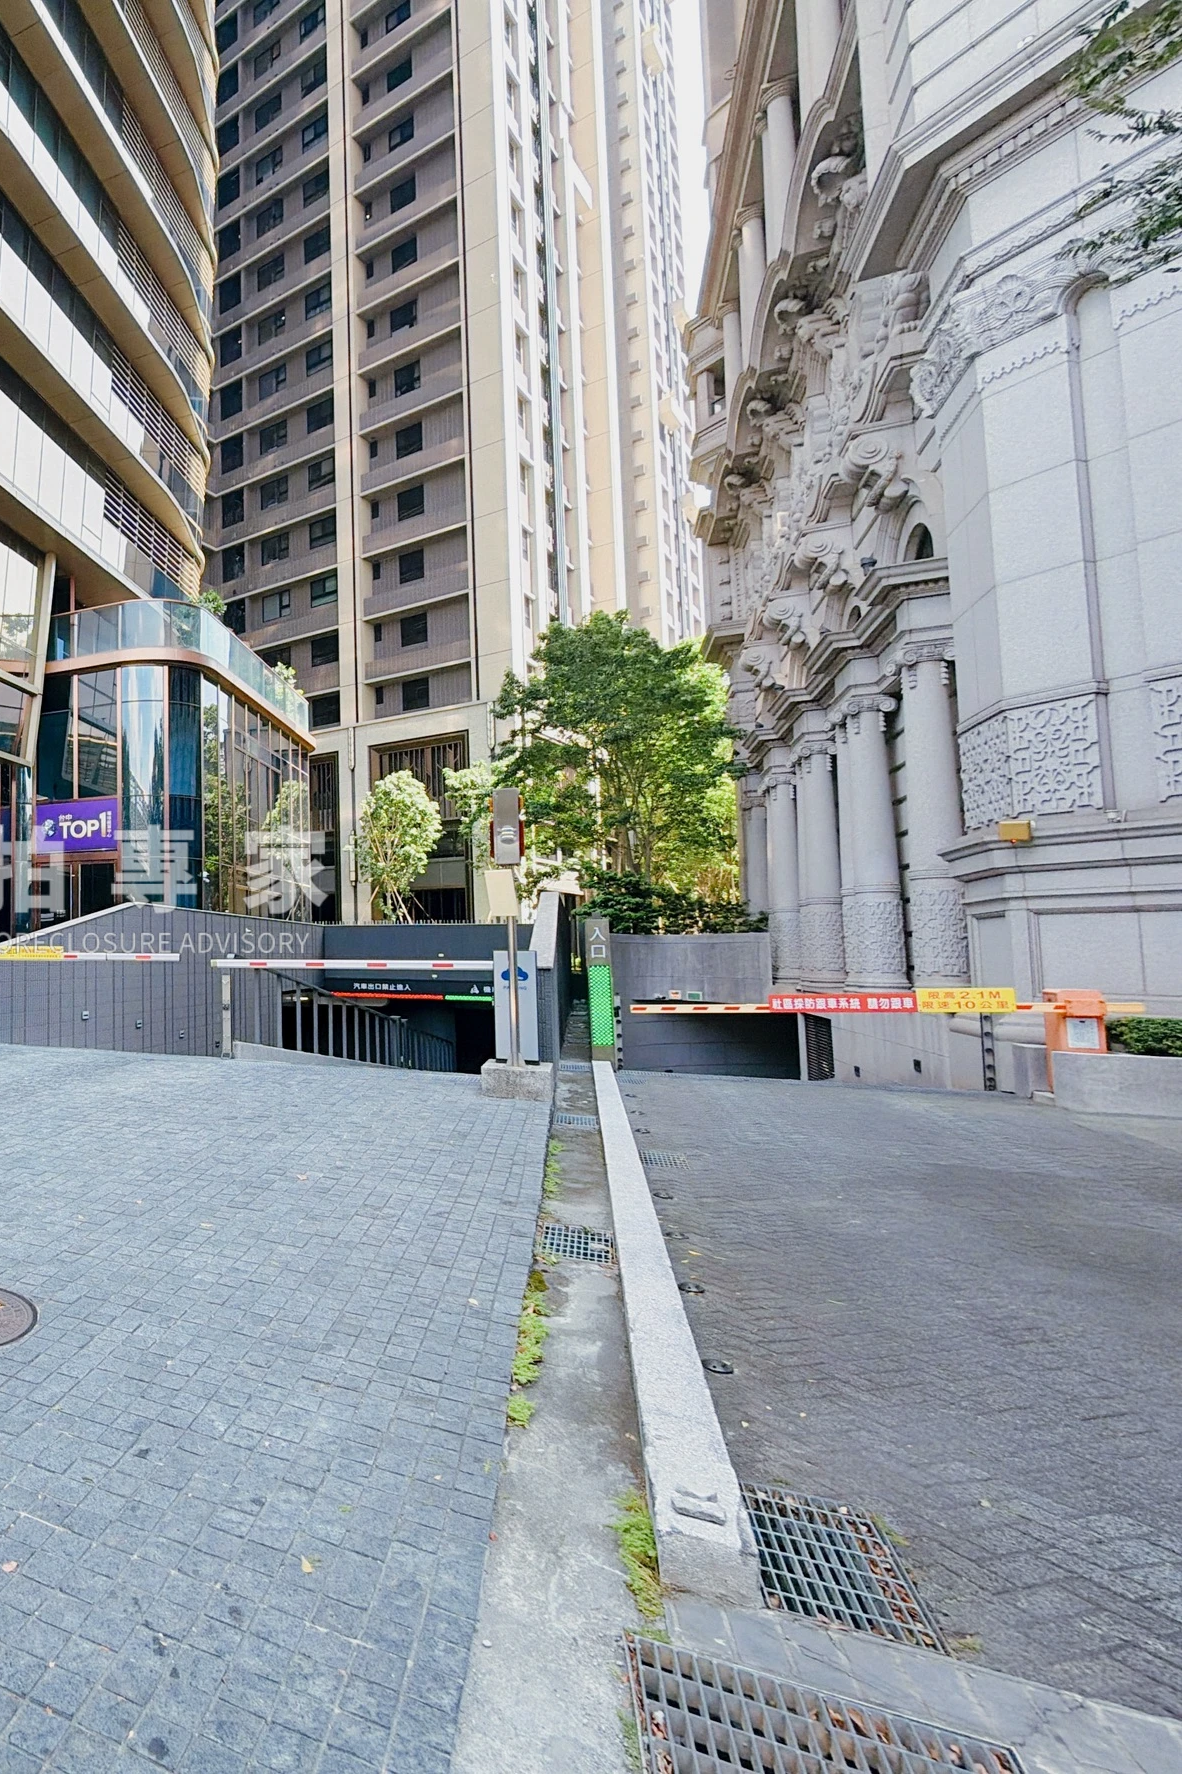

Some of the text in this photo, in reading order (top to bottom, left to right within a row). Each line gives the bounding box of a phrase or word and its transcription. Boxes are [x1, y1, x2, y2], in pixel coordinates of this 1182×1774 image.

[58, 811, 107, 839] TOP1
[589, 926, 606, 959] 入口
[867, 996, 914, 1009] 請勿跟車
[922, 1001, 1009, 1009] 限速10公里
